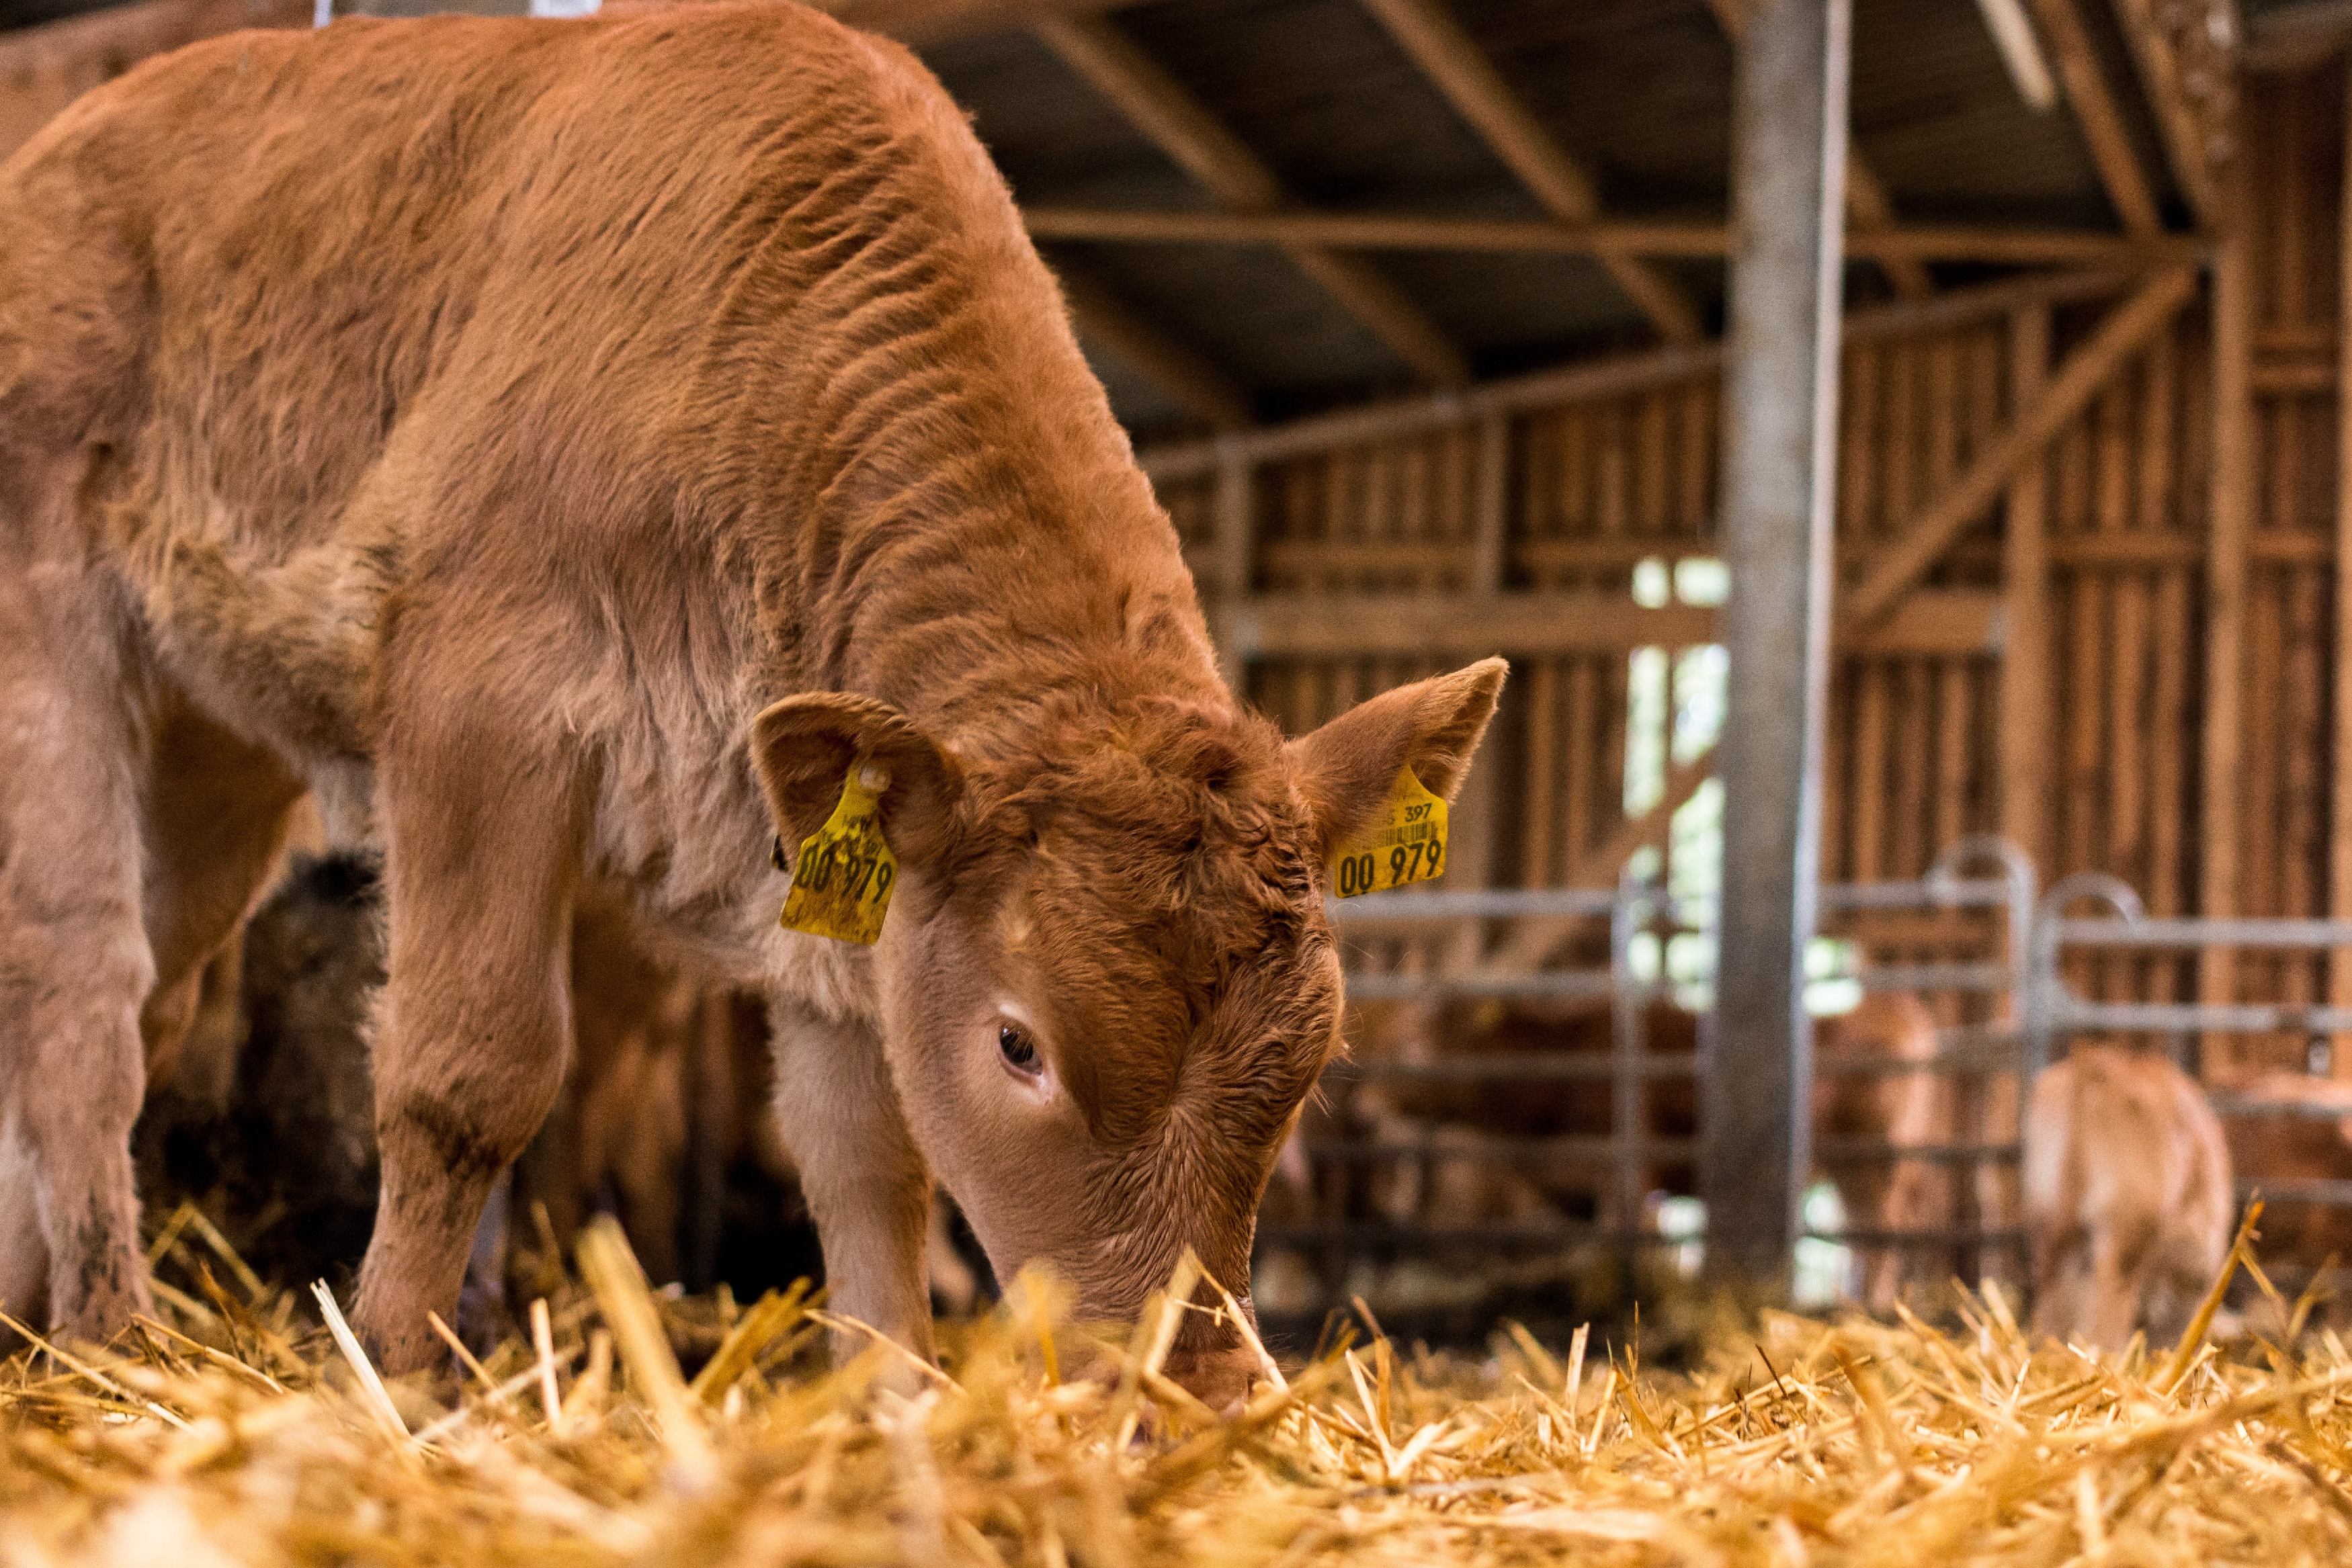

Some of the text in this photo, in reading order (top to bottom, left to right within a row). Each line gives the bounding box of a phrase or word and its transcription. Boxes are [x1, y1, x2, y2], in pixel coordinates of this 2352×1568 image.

[1404, 802, 1433, 823] 397
[798, 845, 892, 904] 00 979
[1341, 839, 1441, 894] 00 979
